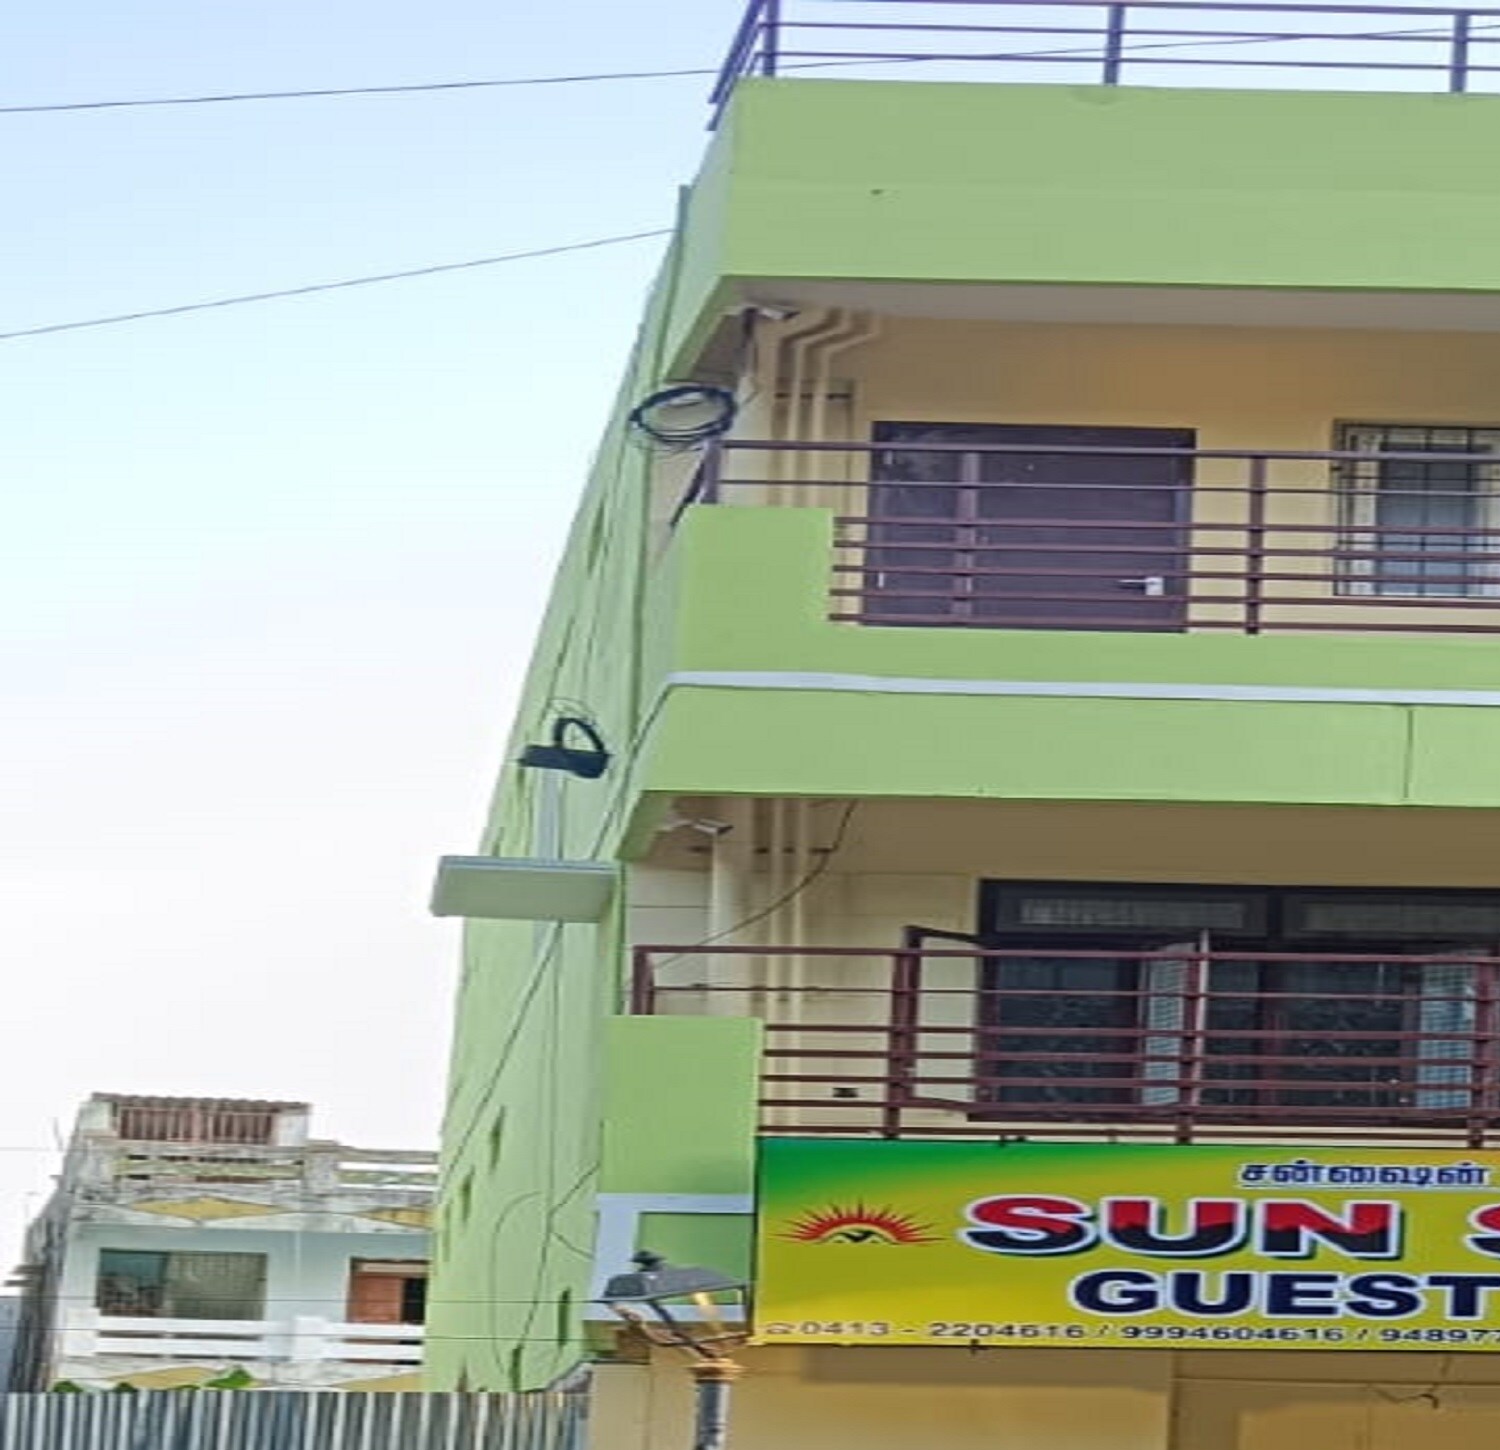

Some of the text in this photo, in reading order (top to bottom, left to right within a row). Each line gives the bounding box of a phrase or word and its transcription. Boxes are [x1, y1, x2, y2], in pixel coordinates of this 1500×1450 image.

[962, 1195, 1404, 1260] SUN
[799, 1322, 890, 1336] 0413
[928, 1322, 1087, 1339] 2204616
[1120, 1324, 1345, 1341] 9994604616
